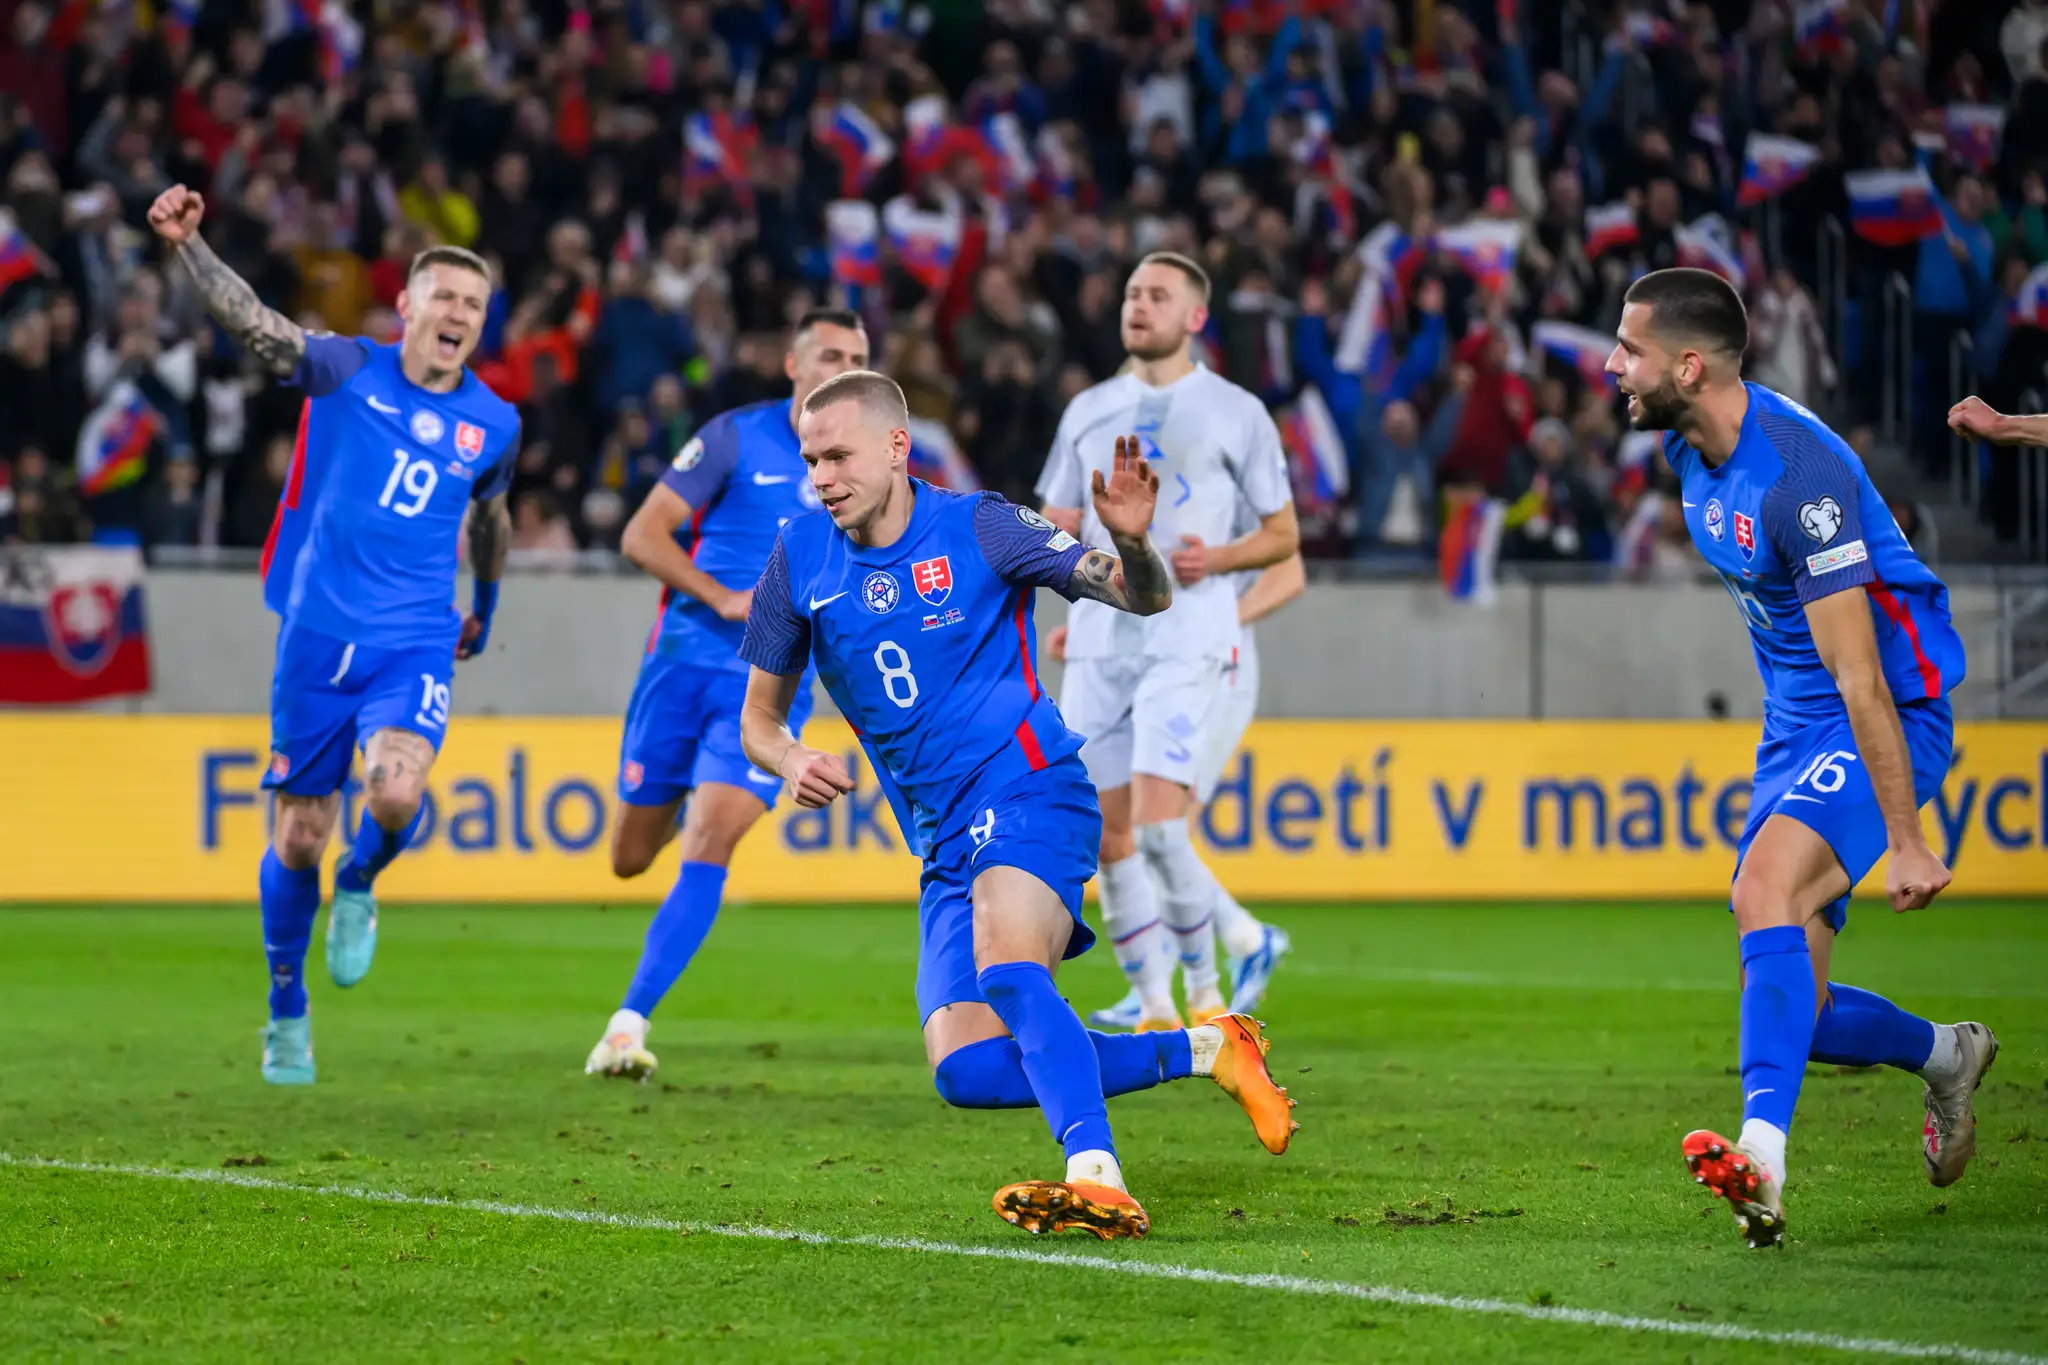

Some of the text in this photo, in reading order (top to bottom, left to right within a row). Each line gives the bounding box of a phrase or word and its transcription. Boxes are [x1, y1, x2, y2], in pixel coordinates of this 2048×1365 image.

[378, 448, 439, 518] 19
[1809, 547, 1865, 569] FOUNDATION
[420, 673, 450, 724] 19
[873, 640, 919, 709] 8
[1795, 750, 1857, 793] 16
[1201, 748, 1392, 850] detí
[1432, 780, 1483, 849] v
[1933, 746, 2048, 870] ýc
